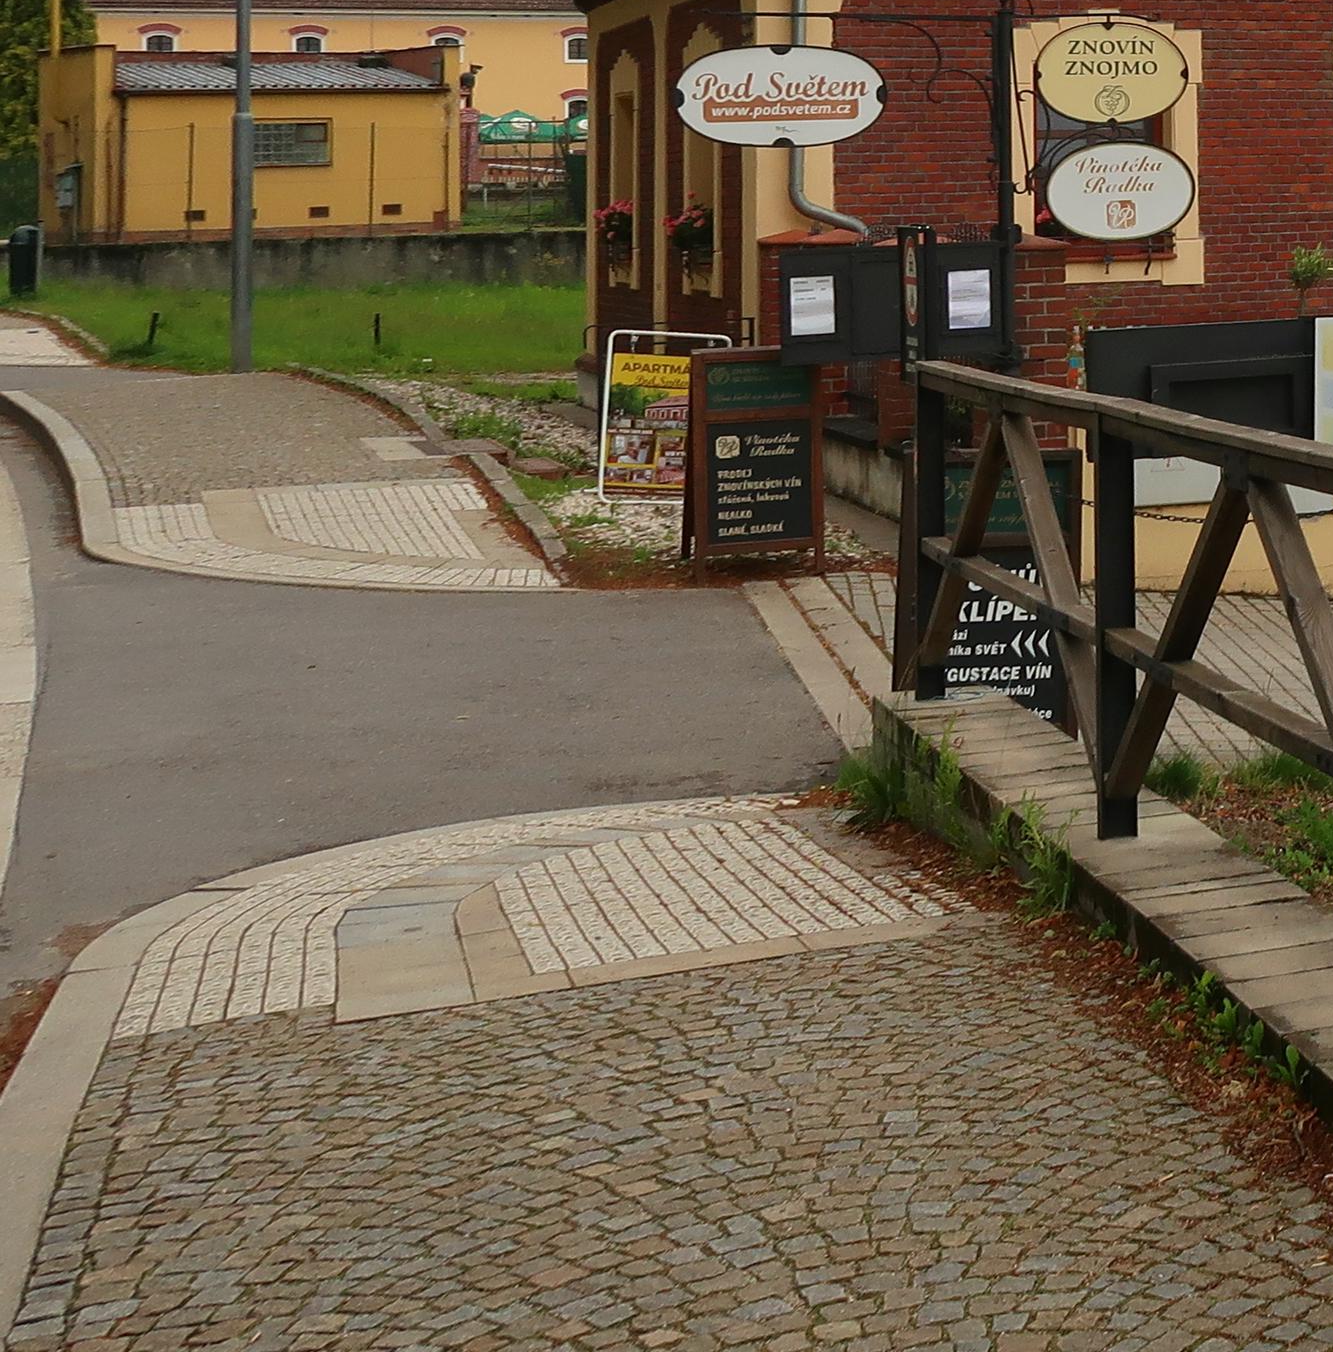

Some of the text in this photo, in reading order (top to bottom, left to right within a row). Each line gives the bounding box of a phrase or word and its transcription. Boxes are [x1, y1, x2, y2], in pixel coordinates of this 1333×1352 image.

[1067, 36, 1155, 55] ZNOVÍN
[1064, 61, 1158, 78] ZNOJMO
[692, 72, 869, 100] Pod Světem
[711, 103, 851, 119] www.podsvetem.cz
[1075, 156, 1162, 174] Vinotéka
[1084, 176, 1155, 195] Radka
[621, 361, 689, 375] APARTMÁ
[784, 476, 802, 487] VÍN
[718, 510, 753, 520] NEALKO
[945, 662, 1052, 682] GUSTACE VÍN
